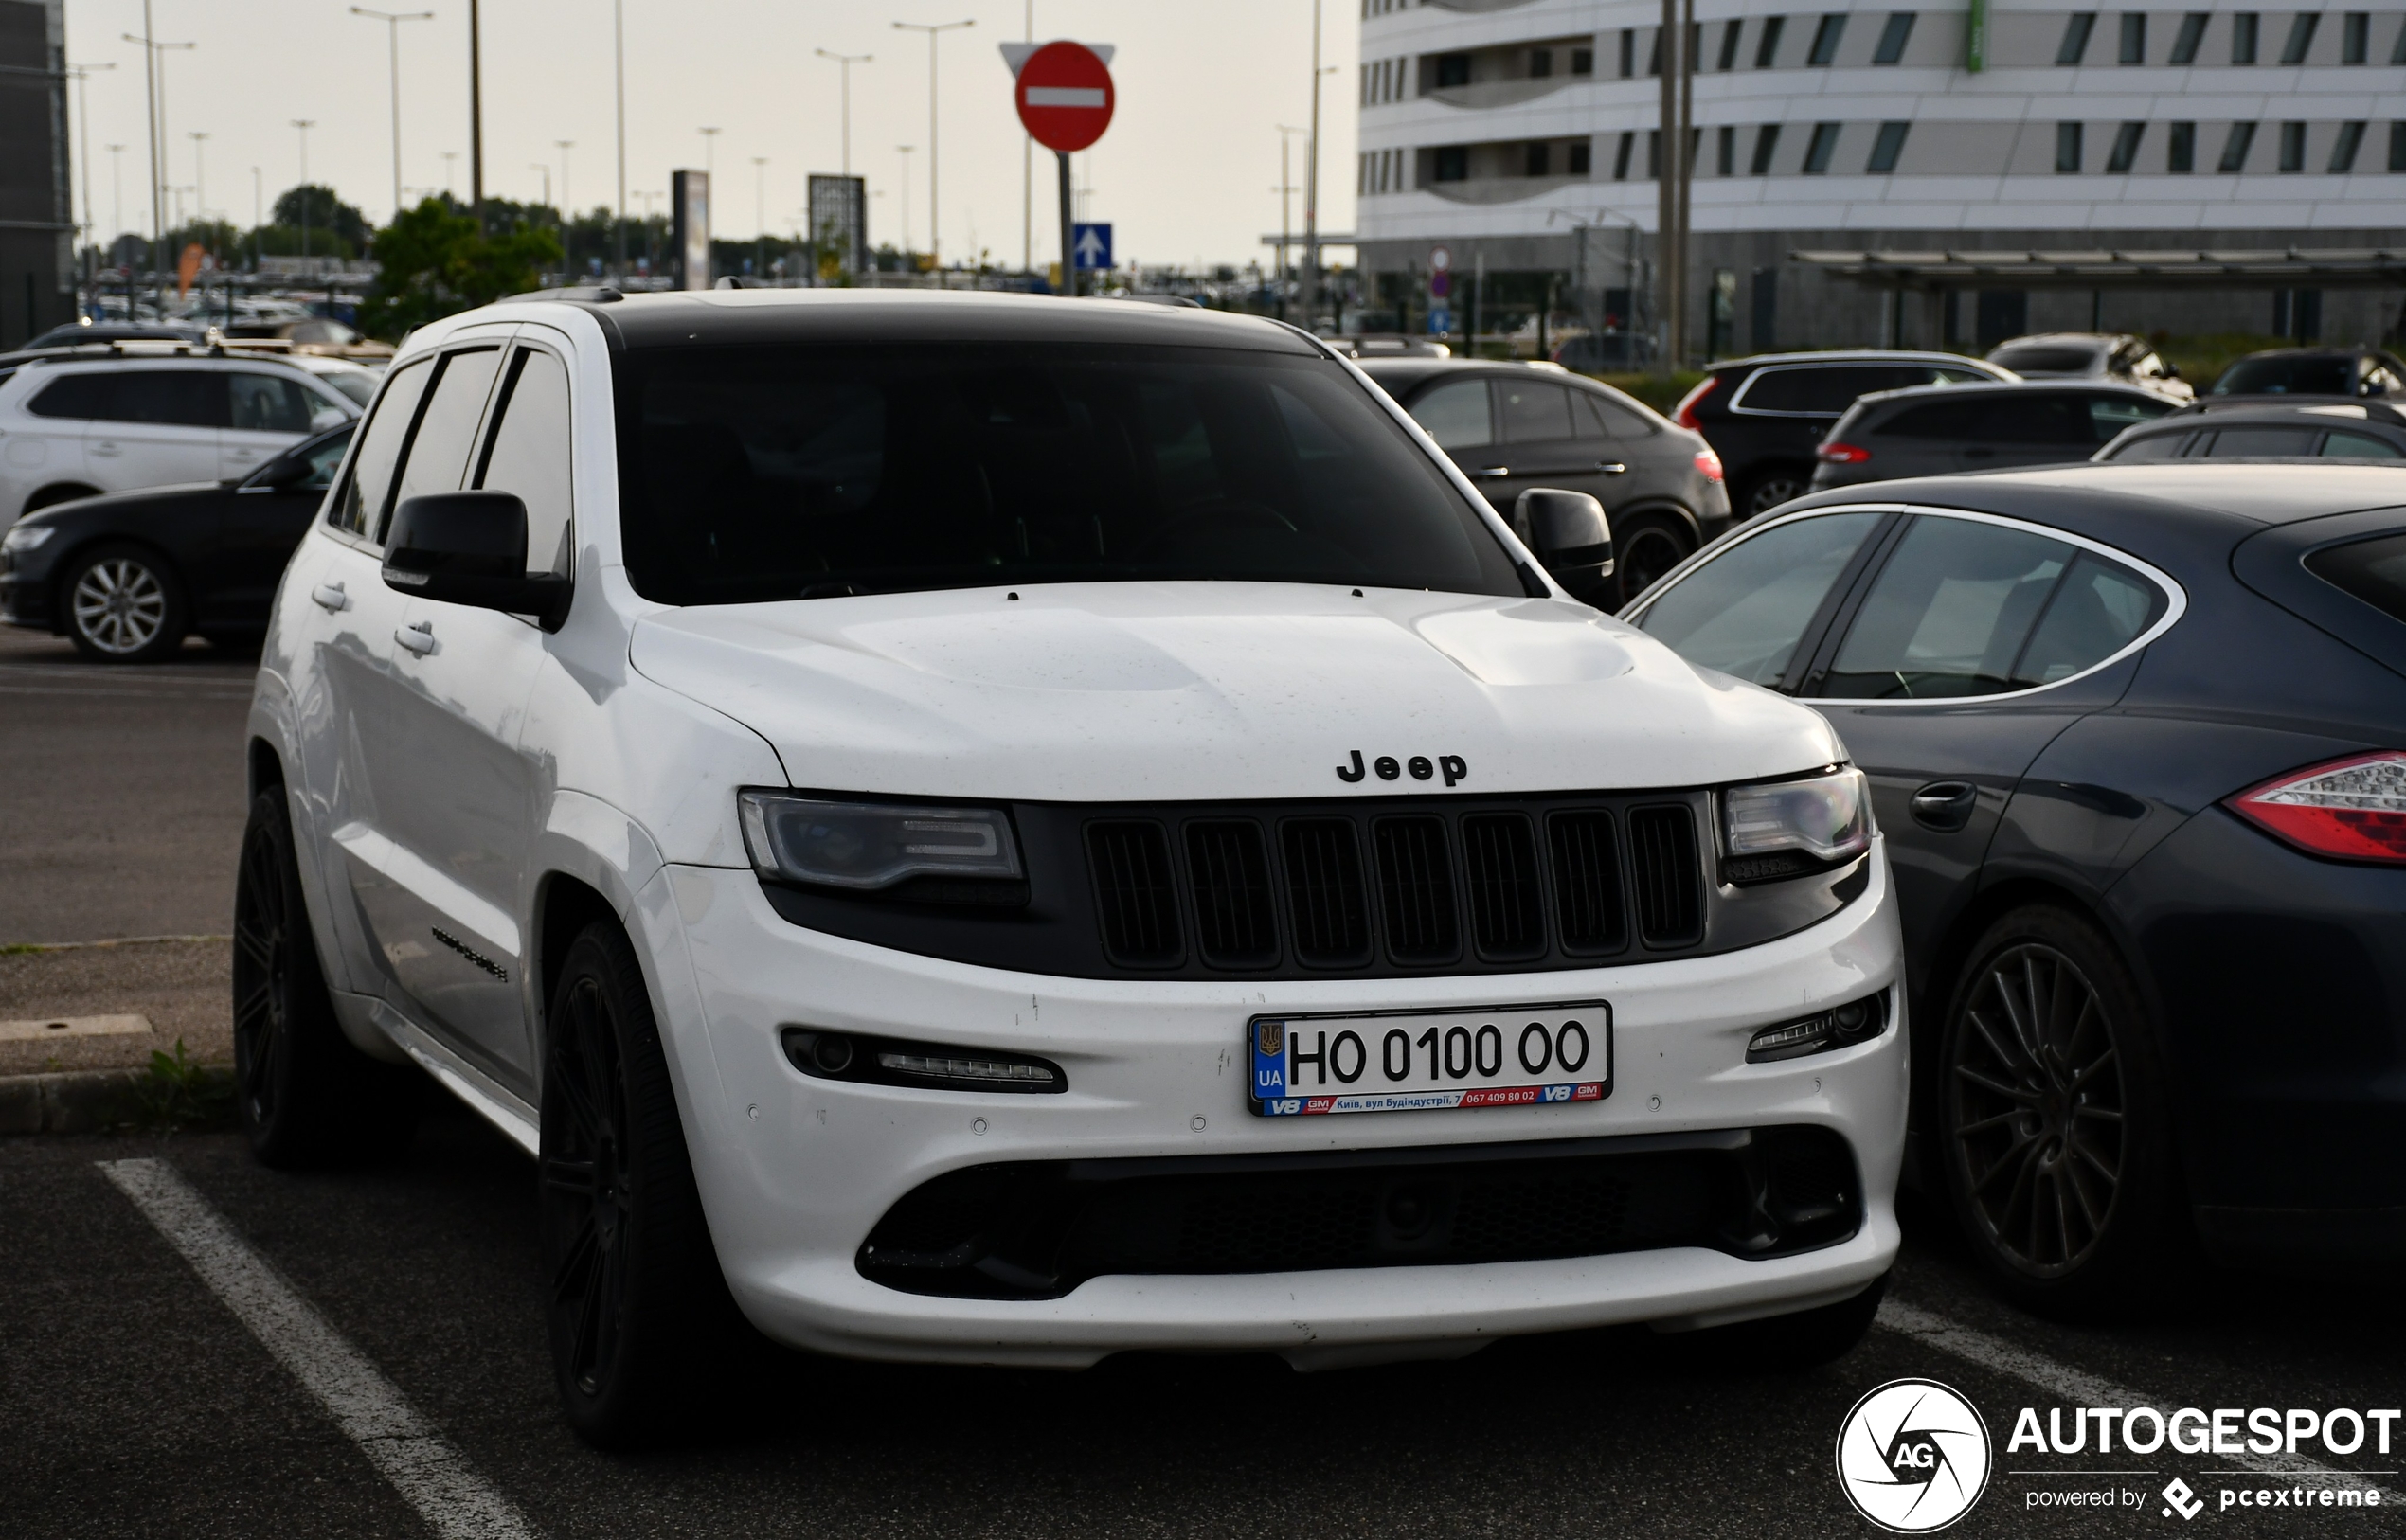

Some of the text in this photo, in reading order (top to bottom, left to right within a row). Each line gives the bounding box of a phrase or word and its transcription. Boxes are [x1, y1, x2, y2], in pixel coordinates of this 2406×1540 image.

[1336, 749, 1468, 787] Jeep
[1289, 1020, 1589, 1085] HO 0100 OO
[1259, 1070, 1283, 1087] UA
[1337, 1093, 1461, 1109] Київ, вул Будіндустрії, 7
[1466, 1091, 1535, 1103] 067 409 80 02
[1544, 1086, 1571, 1101] V8
[1271, 1099, 1301, 1114] V8
[1307, 1100, 1329, 1108] GM
